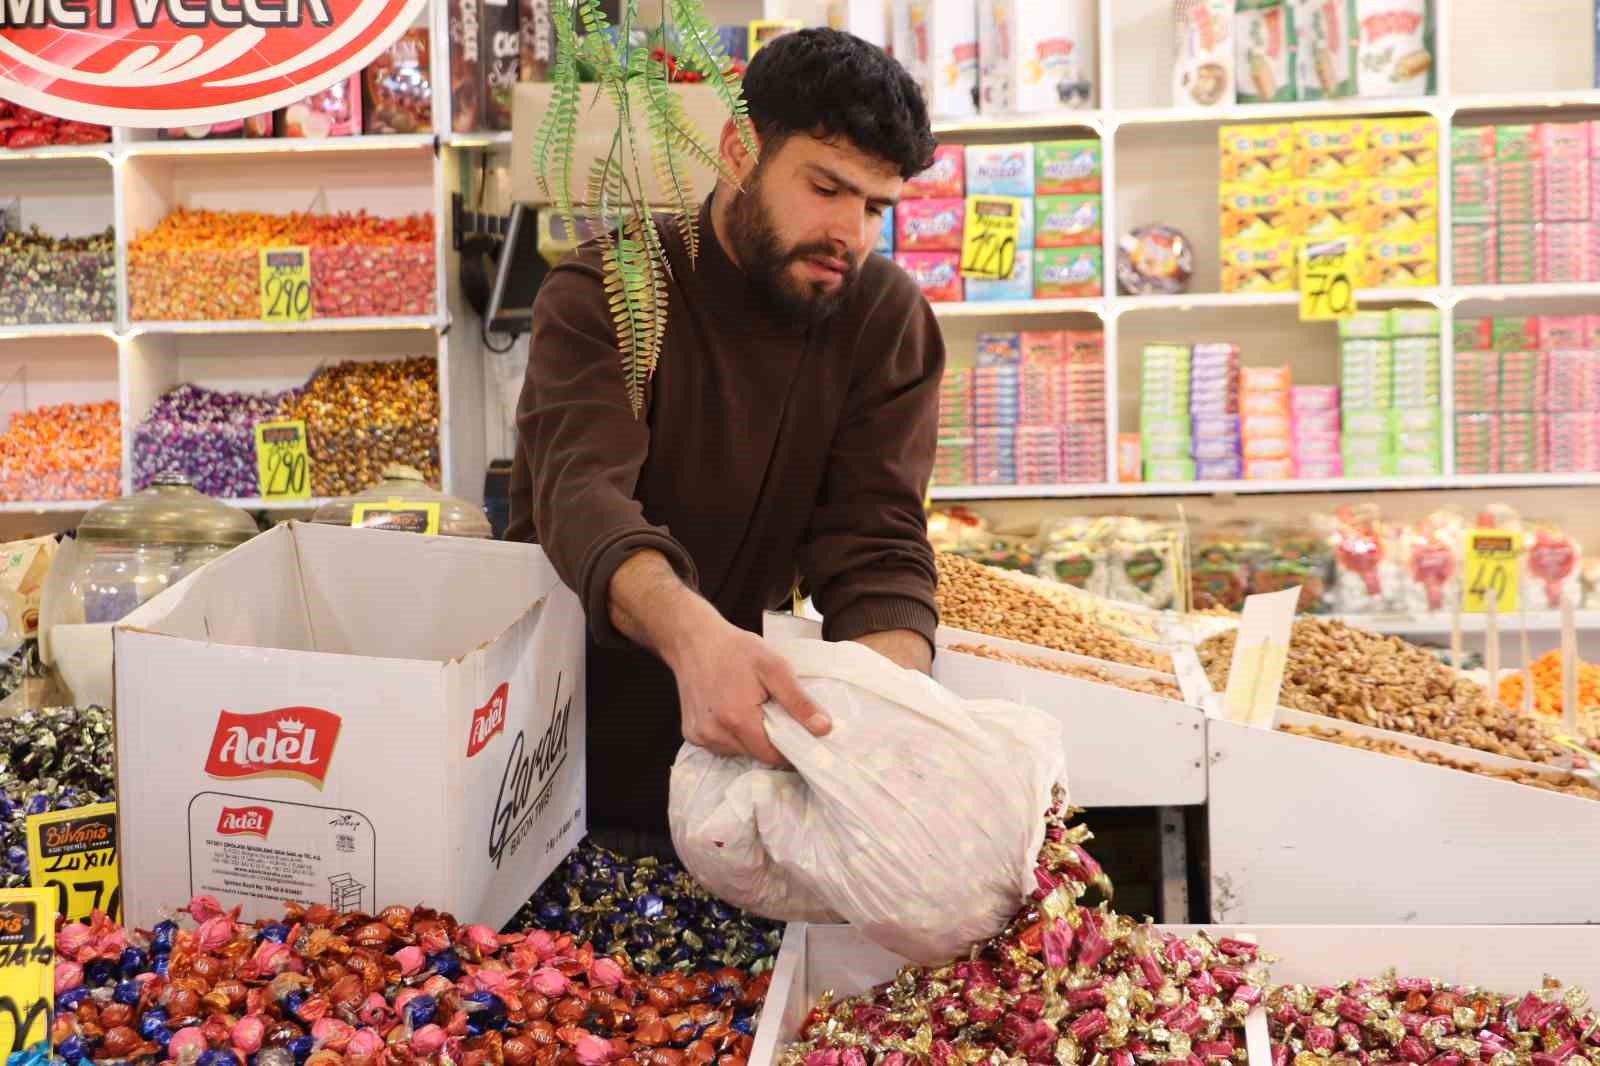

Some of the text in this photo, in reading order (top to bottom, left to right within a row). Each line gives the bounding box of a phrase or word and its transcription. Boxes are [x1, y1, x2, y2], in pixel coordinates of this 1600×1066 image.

[265, 276, 311, 317] 290
[1306, 273, 1351, 313] 70
[266, 452, 306, 495] 290
[1468, 562, 1507, 602] 40
[472, 697, 503, 746] Adel
[219, 726, 319, 764] Adel
[223, 812, 264, 830] Adel
